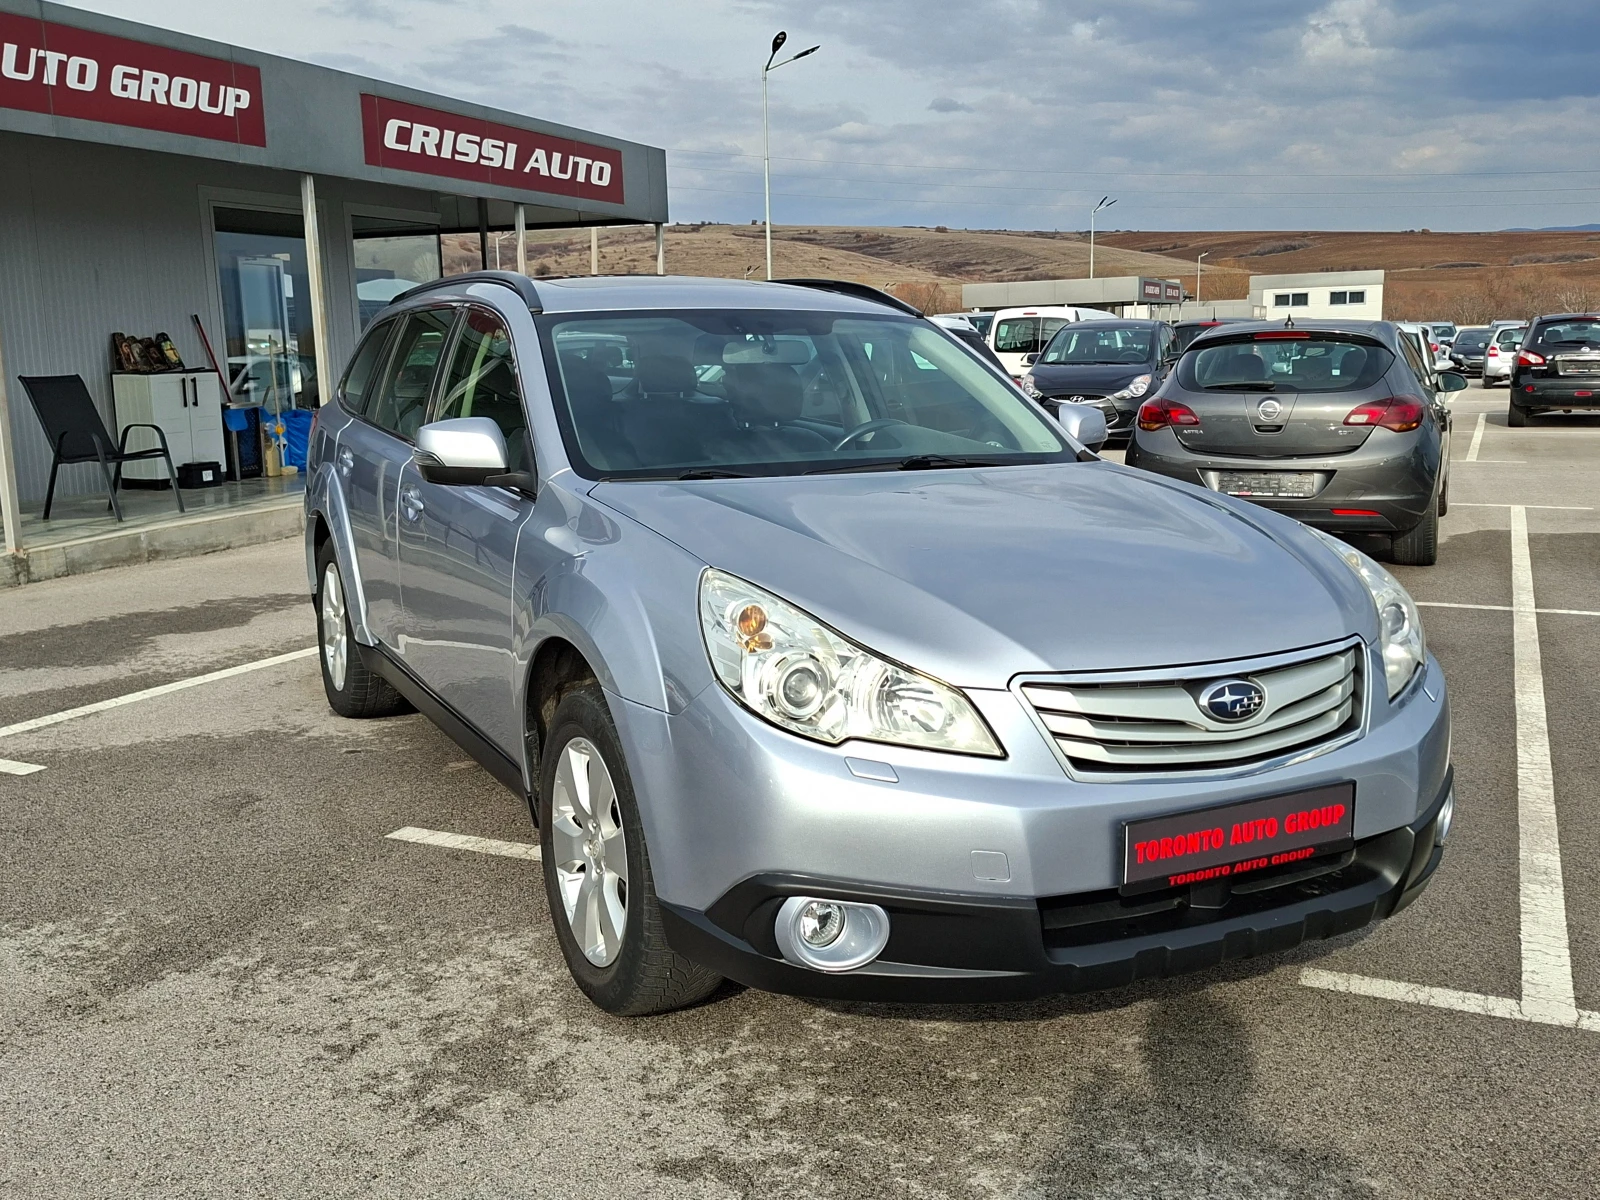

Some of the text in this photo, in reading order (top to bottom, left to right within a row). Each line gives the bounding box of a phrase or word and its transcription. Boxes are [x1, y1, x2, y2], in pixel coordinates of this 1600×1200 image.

[1, 43, 251, 117] UTO GROUP
[383, 118, 612, 187] CRISSI AUTO
[1134, 803, 1346, 864] TORONTO AUTO GROUP
[1168, 847, 1315, 887] TORONTO AUTO GROUP
